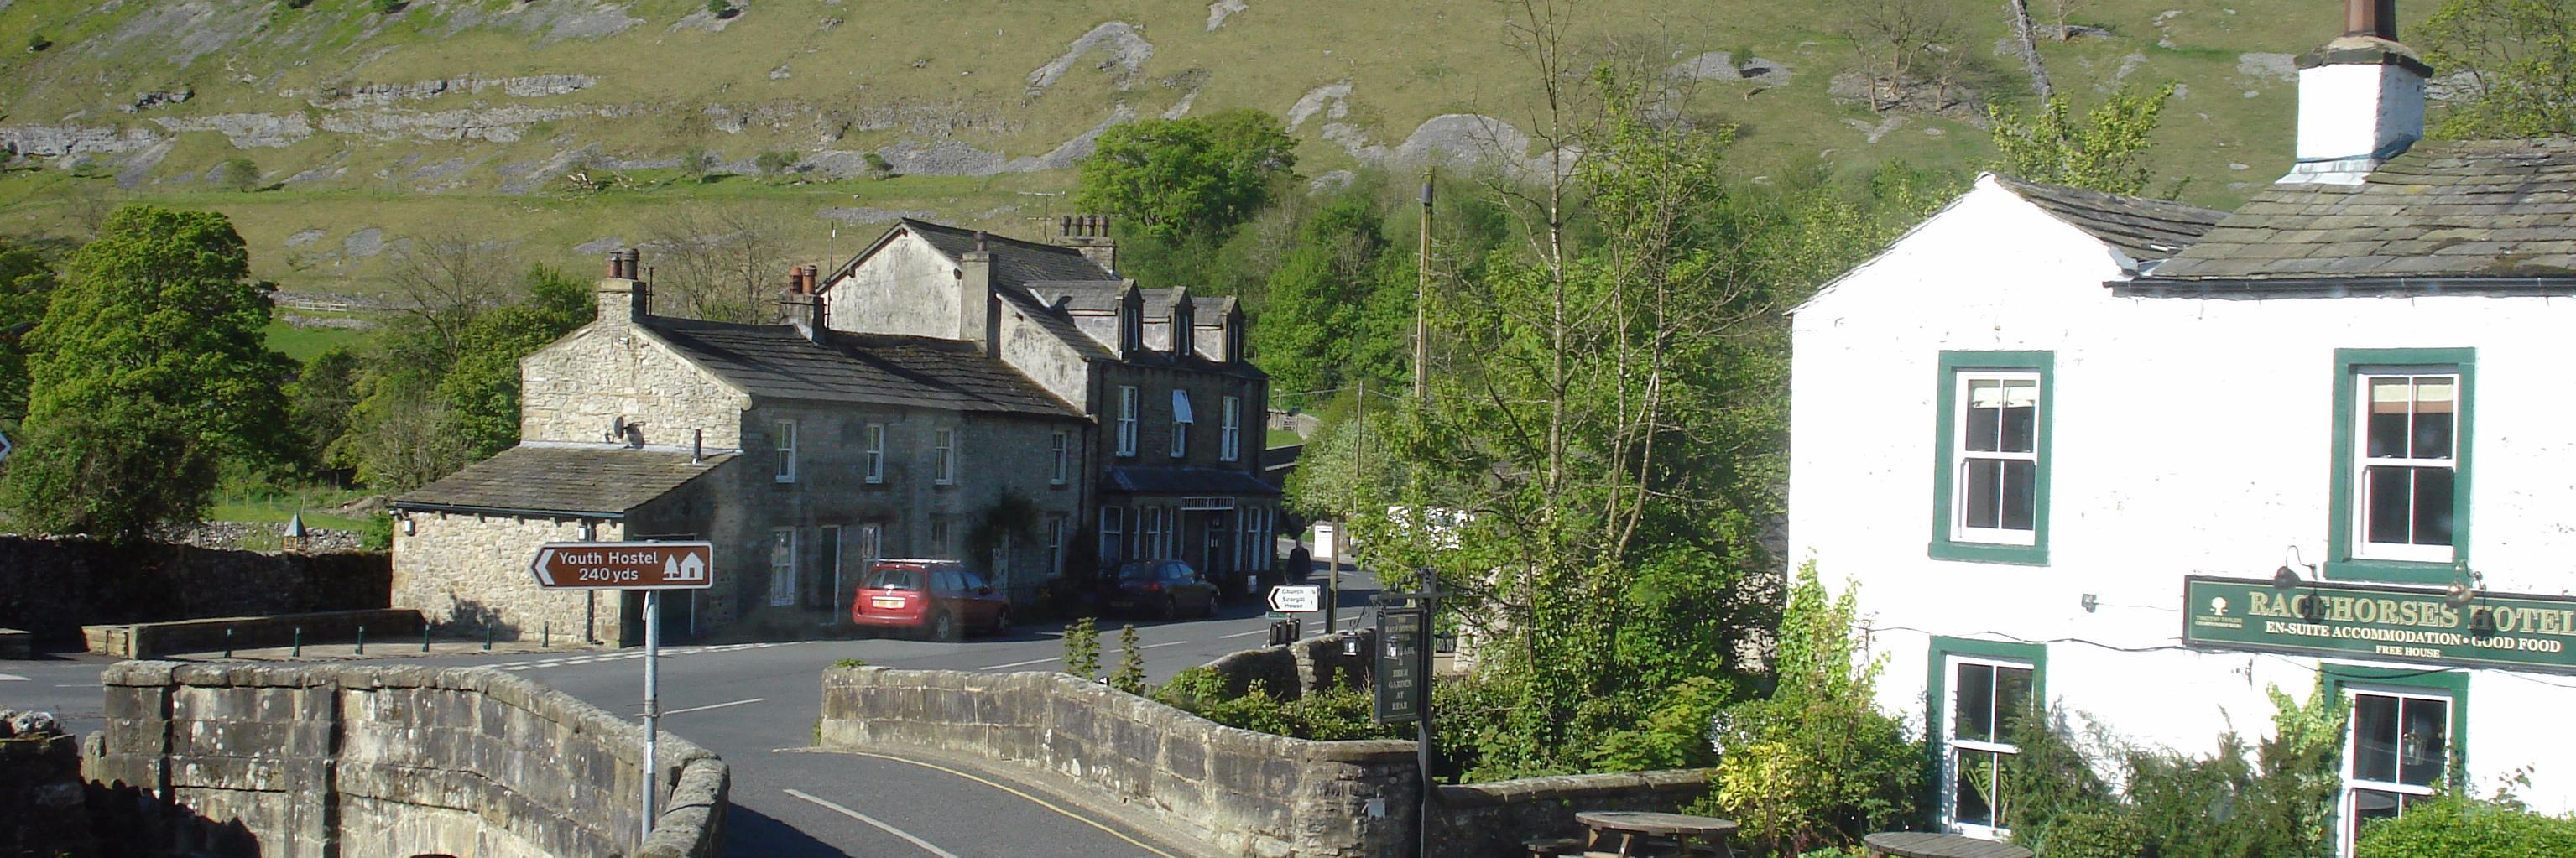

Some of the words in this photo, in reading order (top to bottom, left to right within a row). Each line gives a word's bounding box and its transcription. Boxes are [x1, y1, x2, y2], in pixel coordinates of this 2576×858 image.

[559, 552, 602, 564] Youth
[608, 551, 658, 564] Hostel
[579, 568, 610, 580] 240
[613, 568, 639, 582] yds
[2249, 591, 2459, 629] RACEHORSES
[2266, 621, 2329, 637] EN-SUITE
[2332, 627, 2461, 646] ACCOMMODATION
[2472, 636, 2515, 649] GOOD
[2518, 638, 2561, 653] FOOD
[2375, 645, 2403, 654] FREE
[2405, 647, 2440, 658] HOUSE
[1389, 679, 1412, 689] GARDEN
[1392, 701, 1408, 710] REAR
